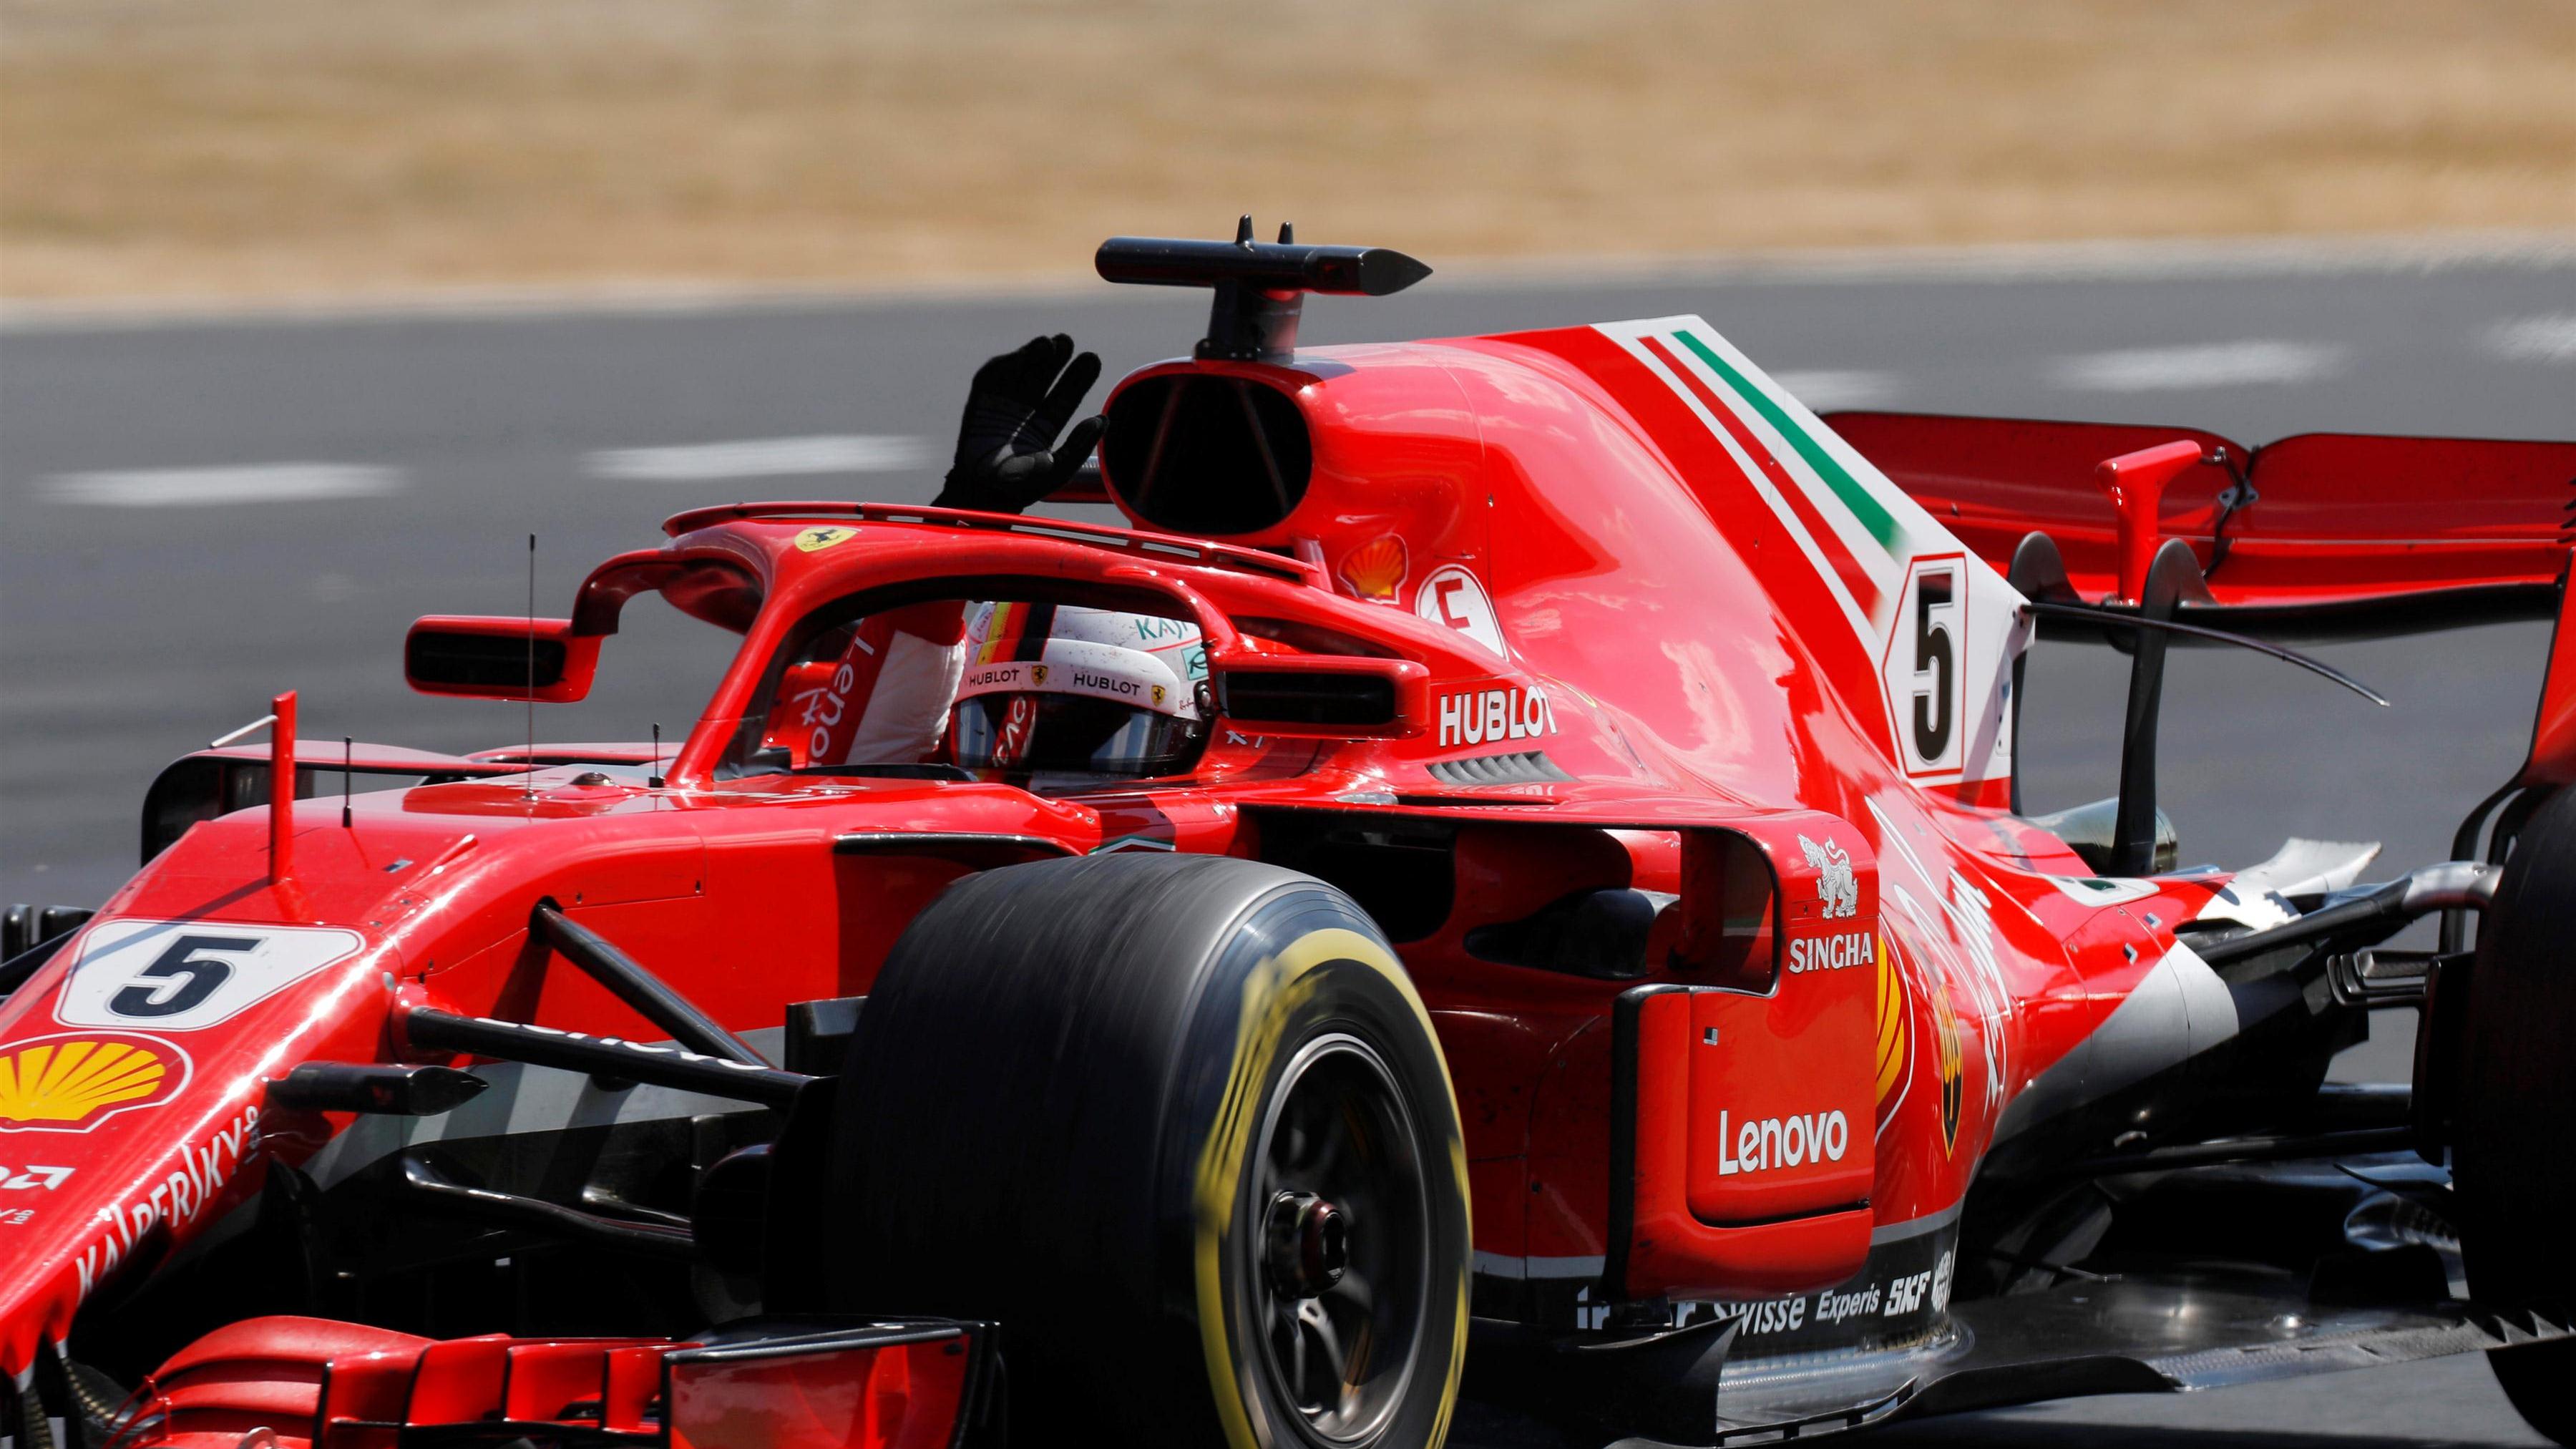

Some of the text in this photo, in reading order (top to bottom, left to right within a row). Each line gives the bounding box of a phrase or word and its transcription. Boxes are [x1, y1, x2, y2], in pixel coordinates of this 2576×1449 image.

[970, 670, 1019, 687] HUBLOT
[1074, 673, 1141, 696] HUBLOT
[1913, 567, 1954, 764] 5
[807, 635, 875, 774] Leno
[1440, 685, 1558, 748] HUBLOT
[107, 934, 265, 1018] 5
[1789, 932, 1874, 974] SINGHA
[1719, 1109, 1848, 1176] Lenovo
[1815, 1282, 1881, 1324] Experis
[1884, 1270, 1931, 1317] SKF
